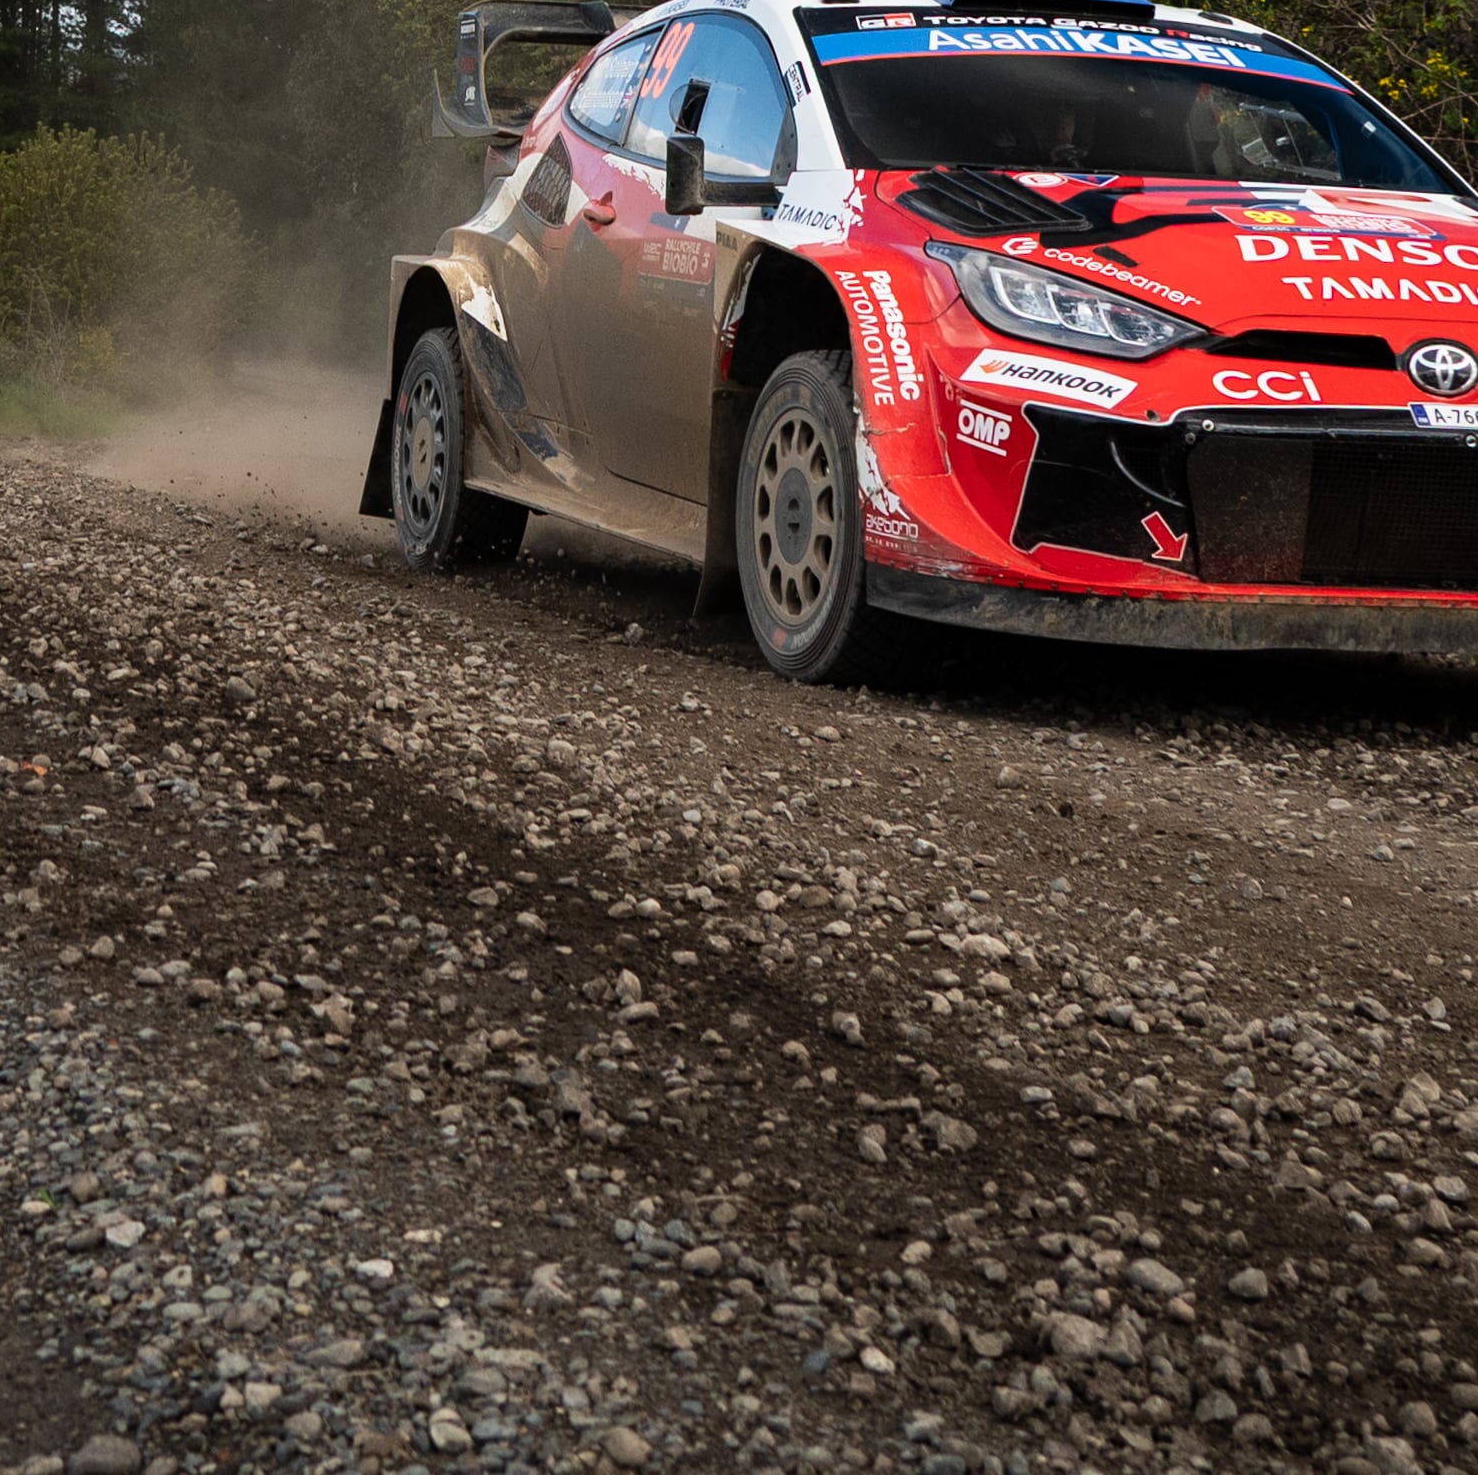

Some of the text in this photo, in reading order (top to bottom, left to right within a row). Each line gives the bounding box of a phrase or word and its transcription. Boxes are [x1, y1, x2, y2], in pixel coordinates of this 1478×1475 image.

[859, 15, 1263, 52] GR TOYOTA GAZOO Racing
[639, 22, 696, 100] 99
[777, 203, 838, 230] TAMADIC
[1243, 210, 1296, 224] 99
[1043, 247, 1198, 307] codebeamer
[834, 270, 895, 406] AUTOMOTIVE
[862, 270, 925, 401] Panasonic
[958, 408, 1011, 446] OMP
